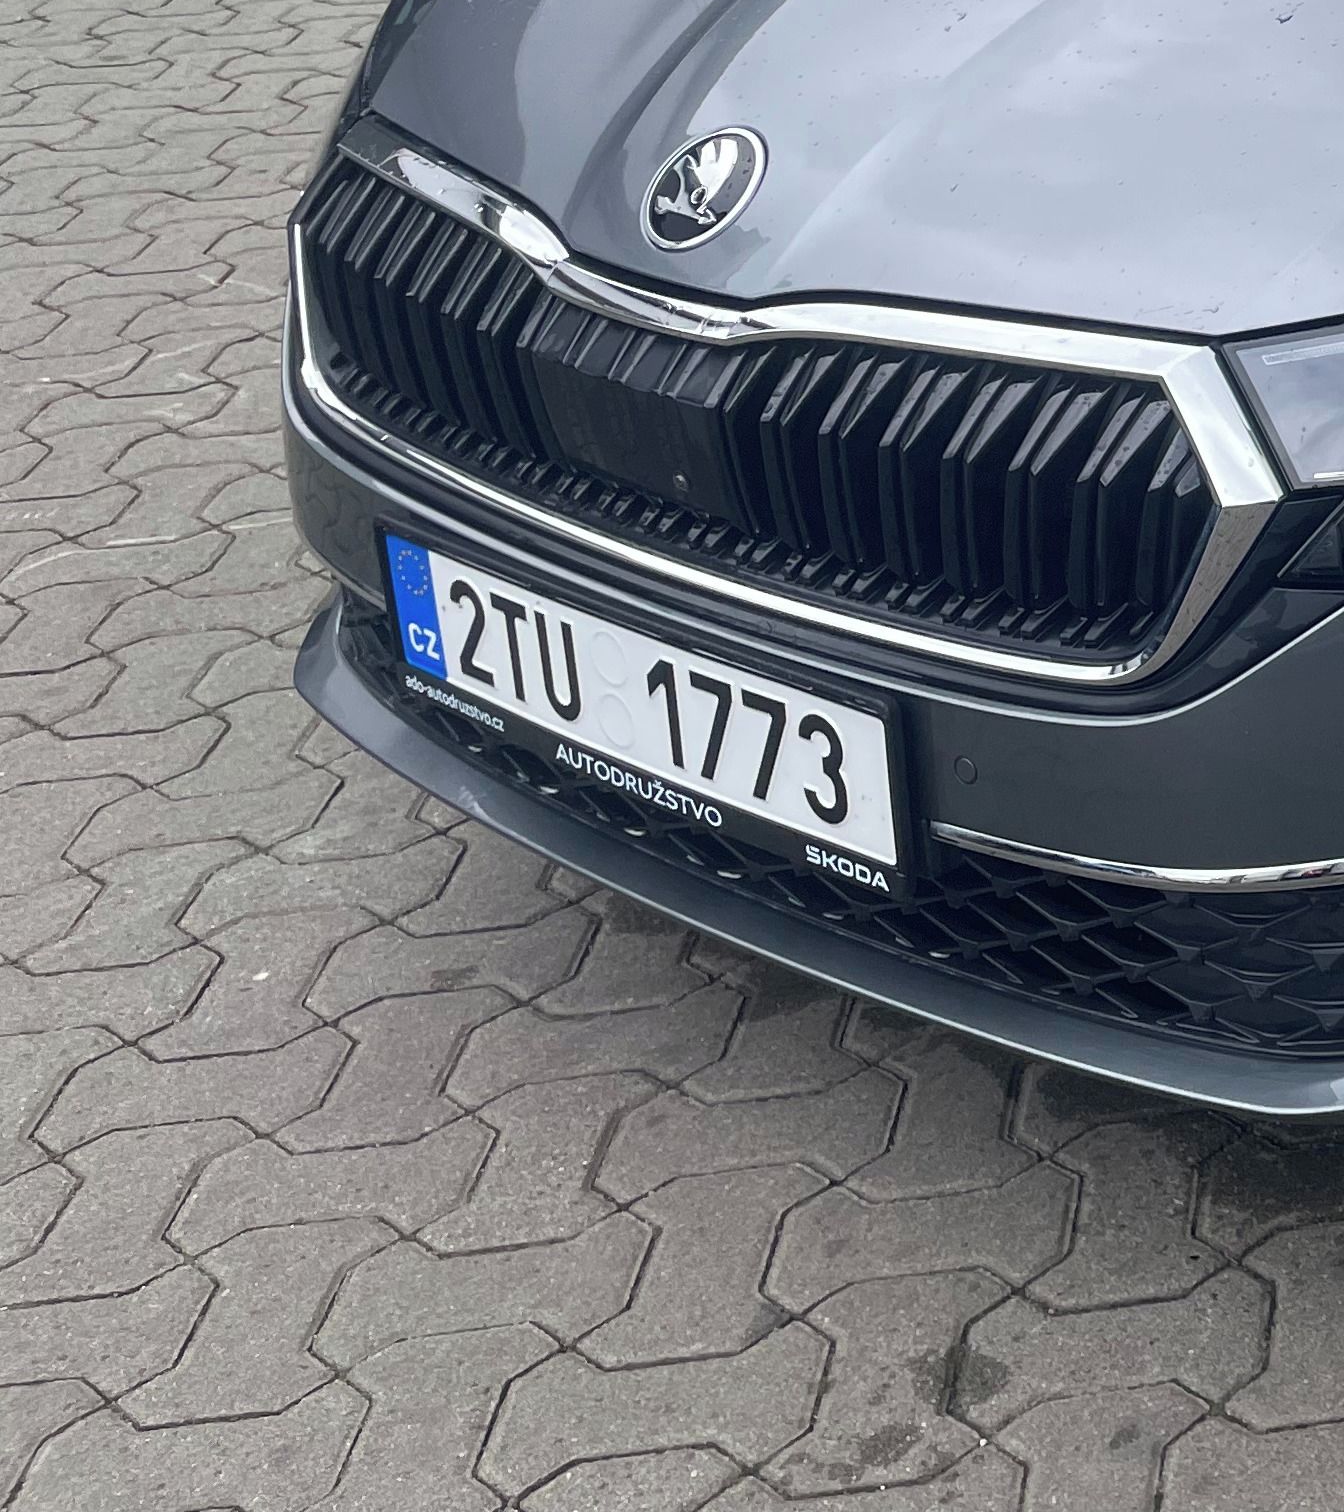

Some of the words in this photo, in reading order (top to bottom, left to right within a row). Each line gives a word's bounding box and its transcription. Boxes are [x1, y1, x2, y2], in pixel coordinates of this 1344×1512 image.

[408, 623, 440, 660] CZ
[405, 675, 505, 732] ado-autodruzstvo.cz
[449, 579, 581, 721] 2TU
[647, 659, 849, 825] 1773
[556, 743, 723, 828] AUTODRUŽSTVO
